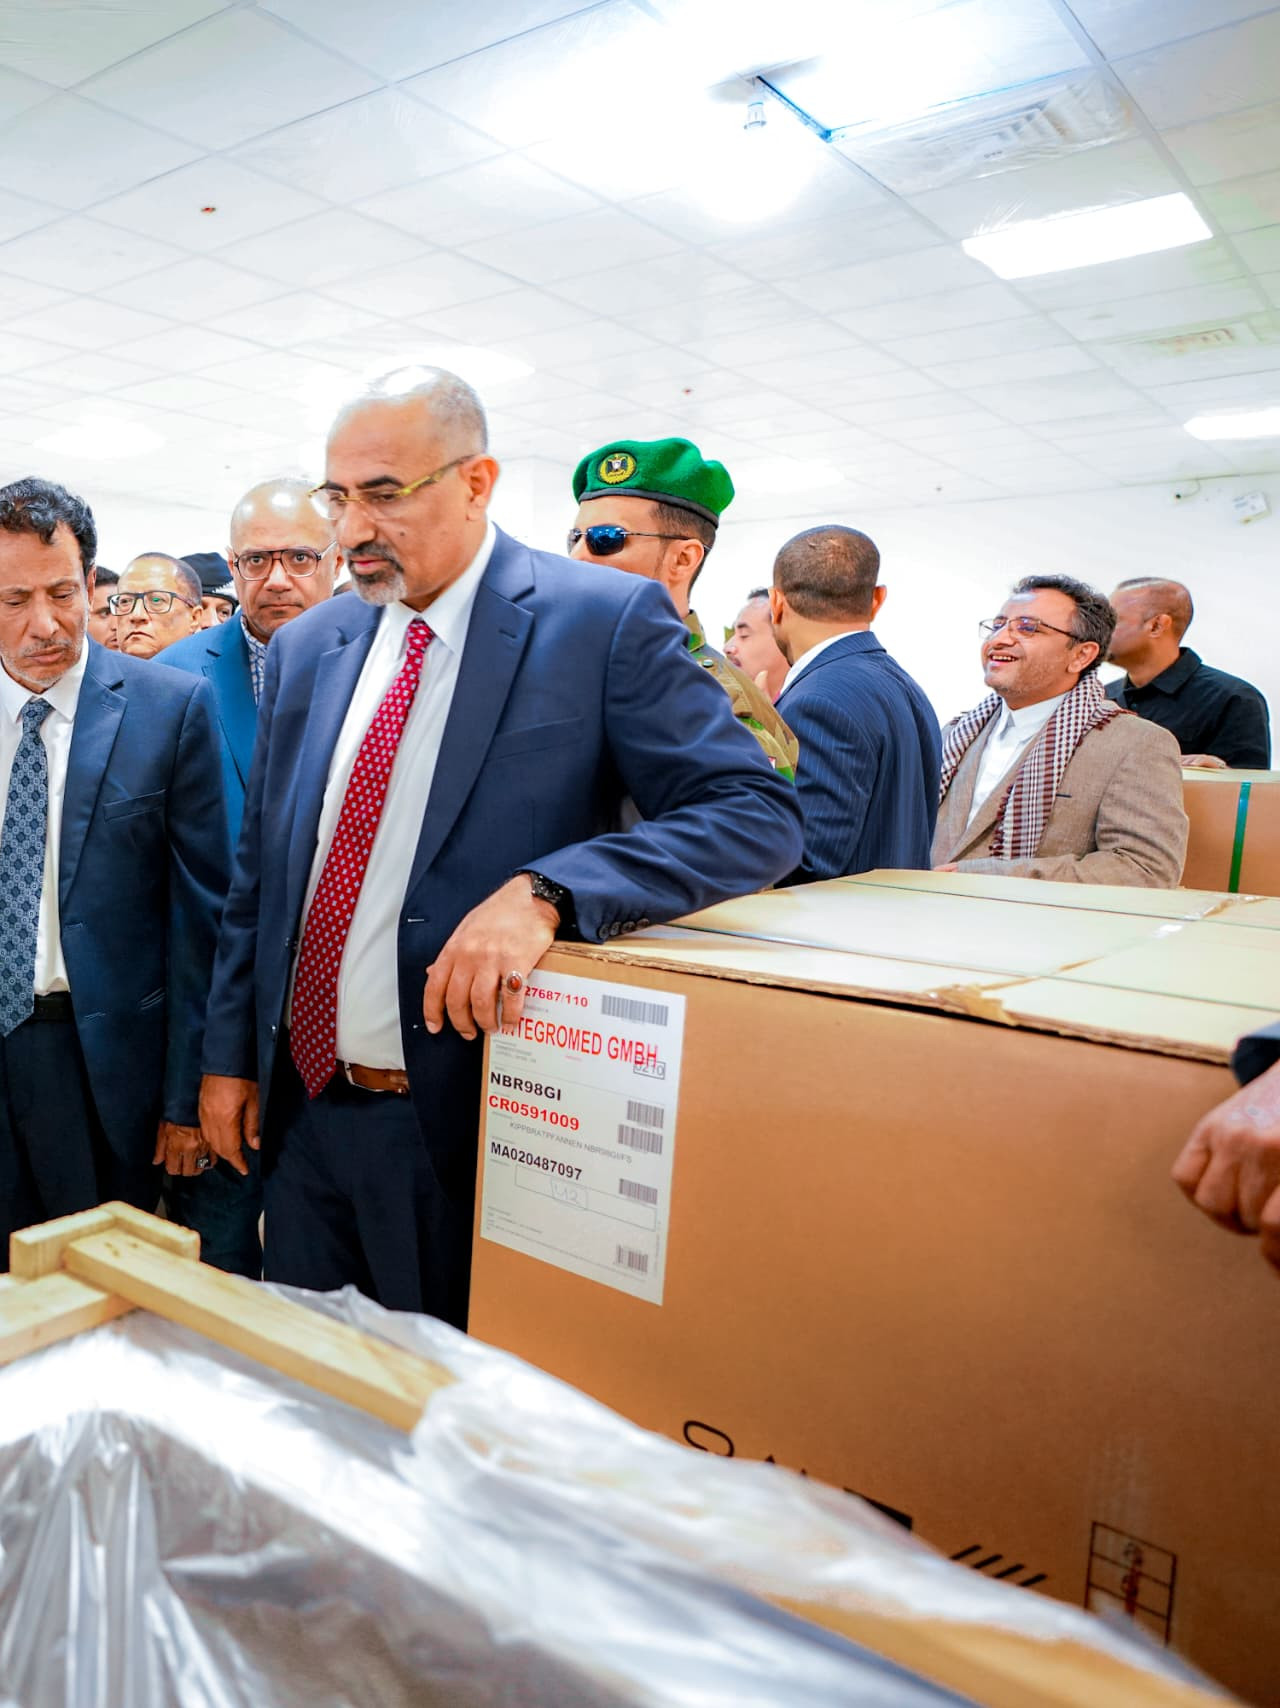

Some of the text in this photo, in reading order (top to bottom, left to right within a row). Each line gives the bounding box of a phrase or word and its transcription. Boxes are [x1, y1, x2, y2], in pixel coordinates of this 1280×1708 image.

[607, 1036, 658, 1068] GMBH
[490, 1071, 561, 1101] NBR98GI
[489, 1095, 579, 1131] CR0591009
[490, 1141, 582, 1181] MA020487097
